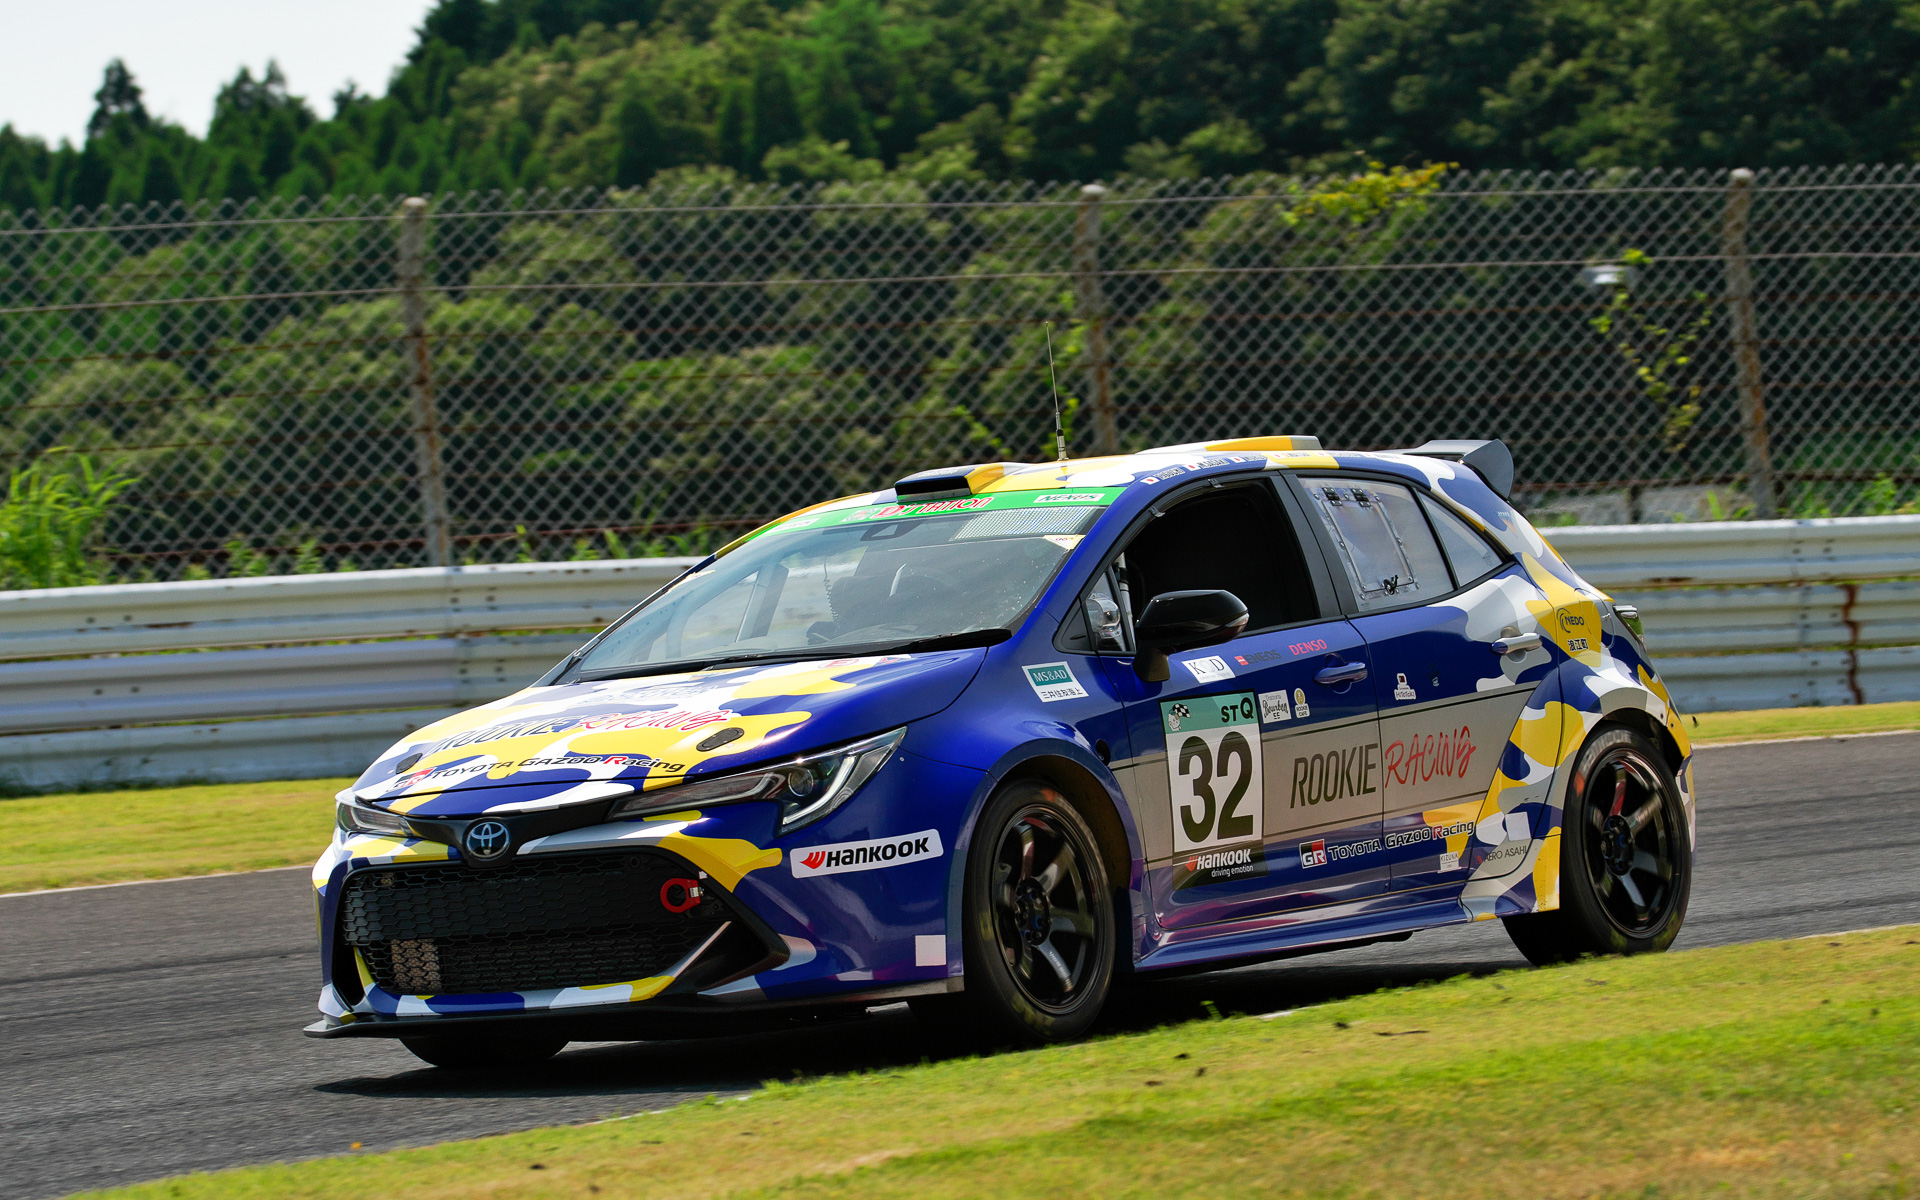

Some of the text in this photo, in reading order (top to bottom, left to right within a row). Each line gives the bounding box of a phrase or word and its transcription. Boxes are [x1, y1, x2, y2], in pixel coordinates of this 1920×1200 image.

[1038, 494, 1097, 502] NEXUS
[1564, 615, 1585, 626] NEDO
[1288, 639, 1328, 656] DENSO
[1243, 650, 1282, 664] ENEOS
[1032, 669, 1068, 683] MS&AD
[423, 708, 735, 757] ROOKIE RACING
[432, 760, 514, 779] TOYOTA
[517, 756, 600, 767] GAZOO
[601, 755, 686, 773] Racing
[1289, 725, 1477, 809] ROOKIE RACING
[1178, 731, 1254, 843] 32
[826, 837, 929, 867] HANKOOK
[1303, 821, 1475, 866] GR TOYOTA GAZOO Racing
[1196, 849, 1252, 870] HANKOOK
[1440, 853, 1458, 861] KIZUNA
[1483, 845, 1528, 862] AERO ASAHI
[1211, 864, 1254, 877] driving emotion
